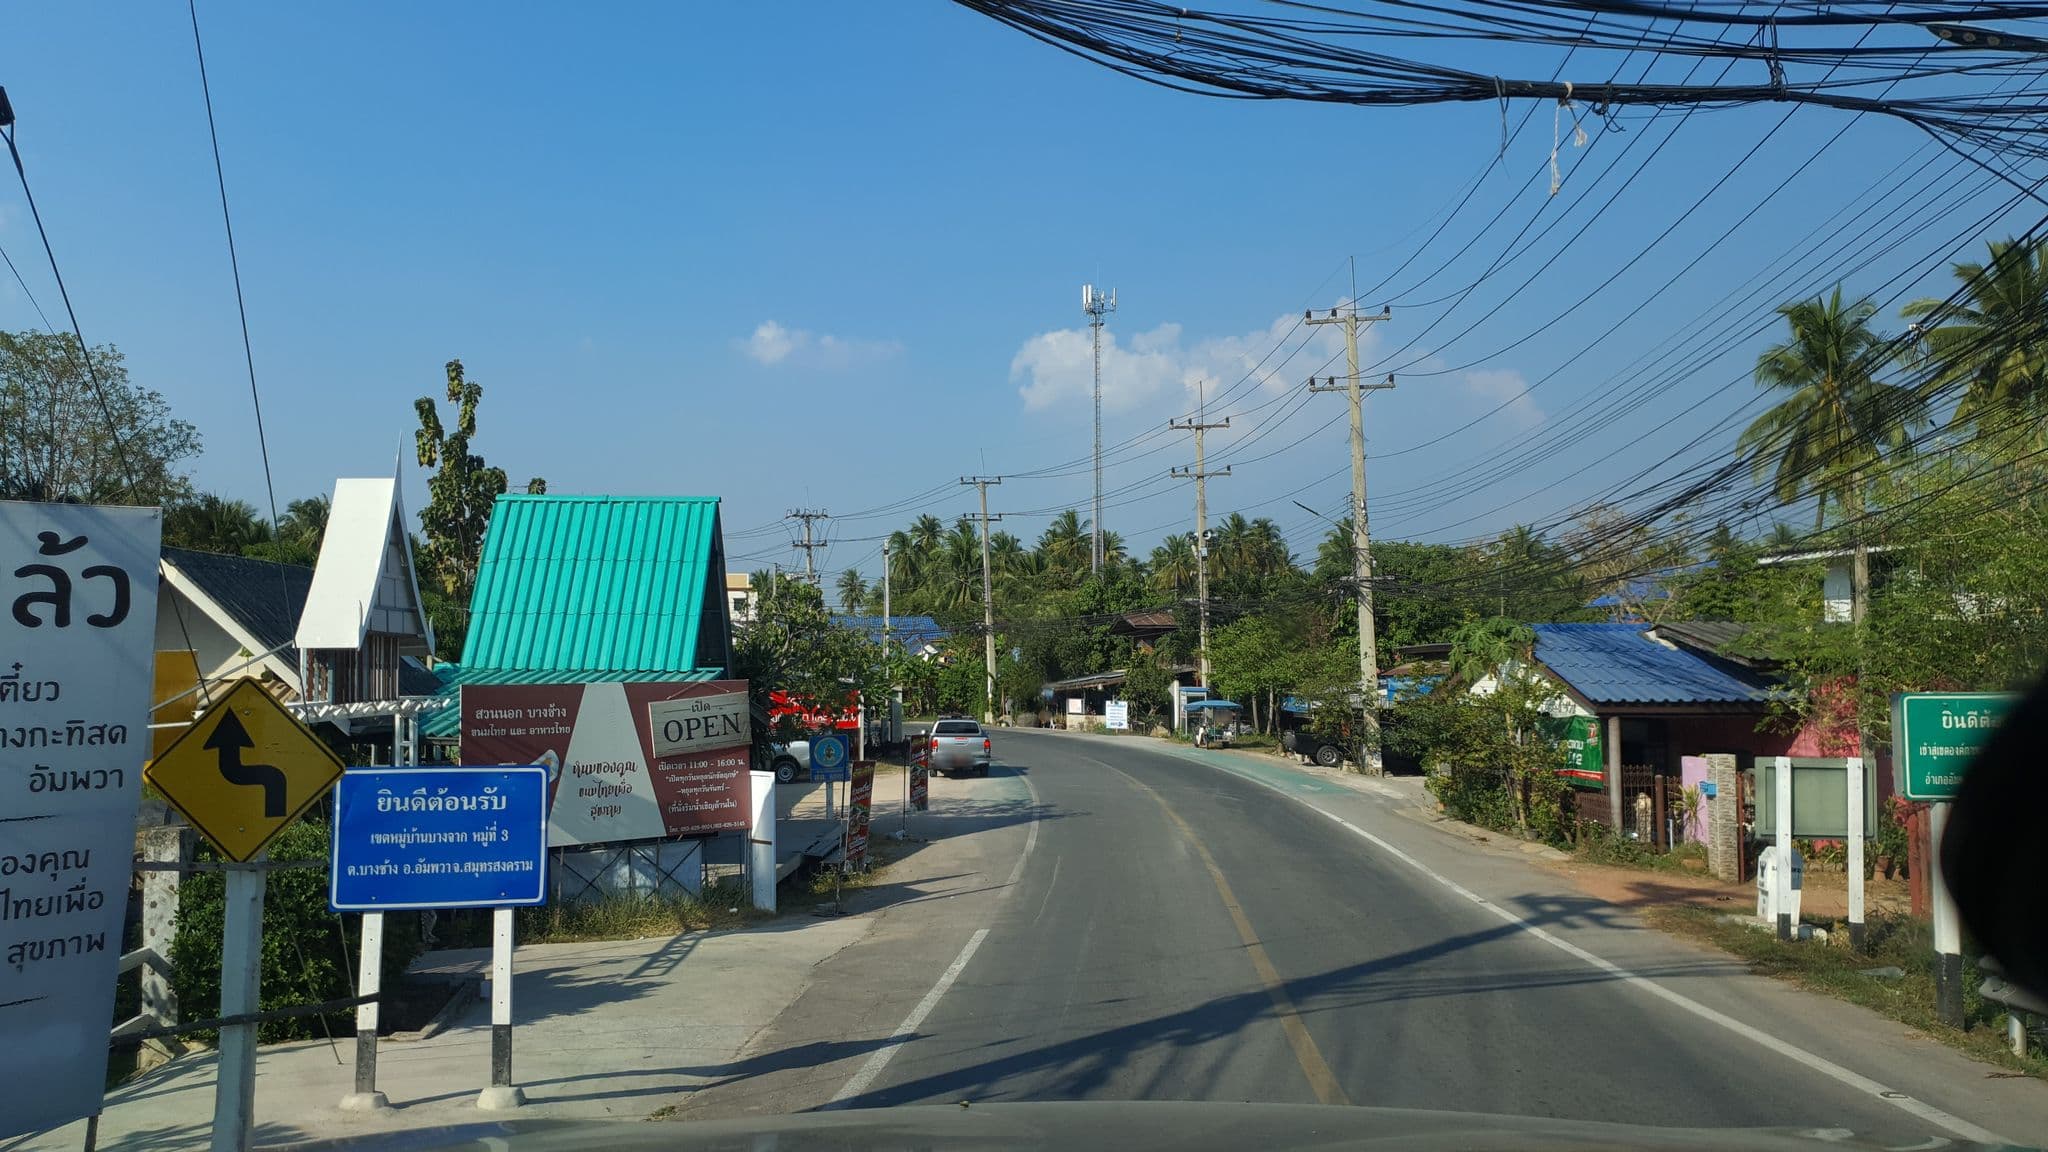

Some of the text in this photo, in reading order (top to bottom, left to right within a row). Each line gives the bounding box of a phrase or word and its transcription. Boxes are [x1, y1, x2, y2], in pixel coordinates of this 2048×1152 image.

[475, 702, 567, 719] สวนนอก บางช้าง
[509, 727, 527, 736] และ
[529, 722, 571, 735] อาหารไทย
[663, 712, 741, 743] OPEN
[689, 760, 708, 769] 11:00
[717, 758, 736, 767] 16:00
[29, 764, 124, 793] อัมพวา
[377, 786, 507, 812] ยินดีต้อนรับ
[370, 820, 509, 848] เขตหมู่บ้านบางจาก หมู่ที่ 3
[347, 858, 399, 876] ต.บางช้าง
[7, 931, 105, 973] สุขภาพ
